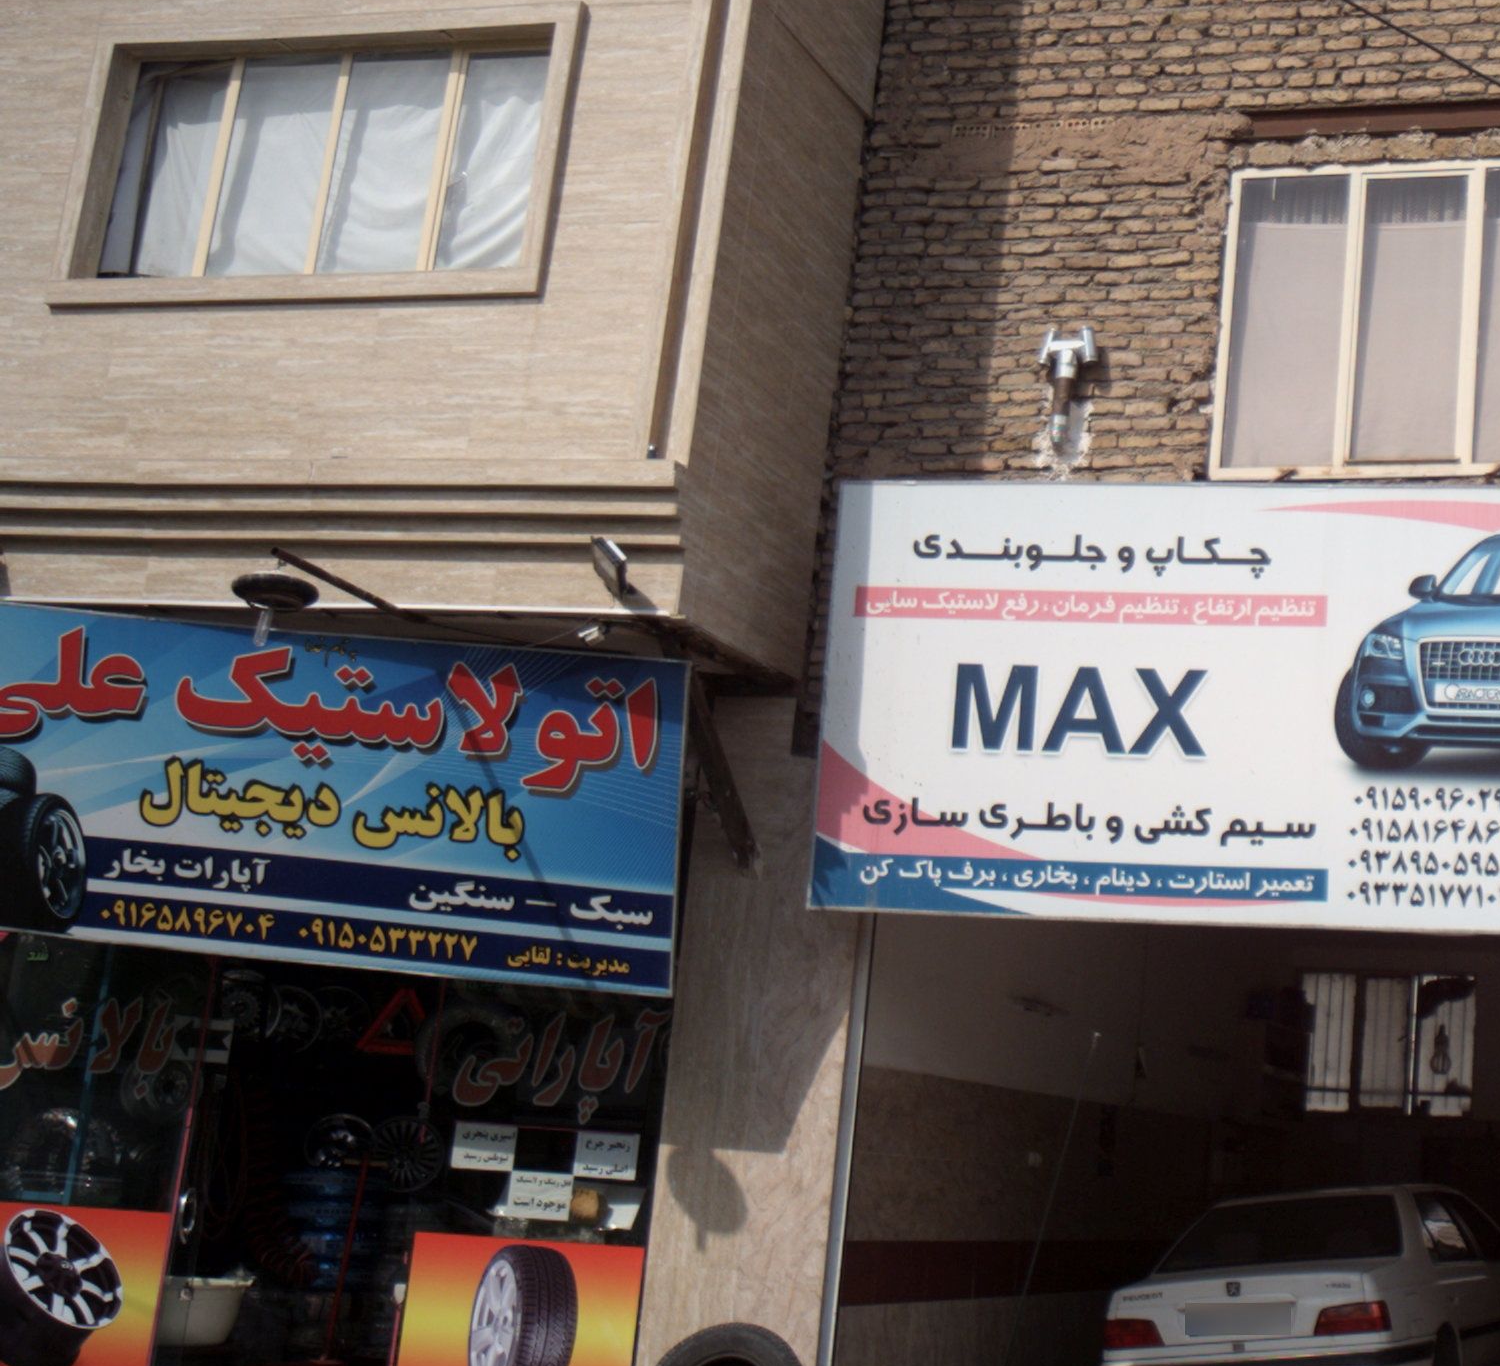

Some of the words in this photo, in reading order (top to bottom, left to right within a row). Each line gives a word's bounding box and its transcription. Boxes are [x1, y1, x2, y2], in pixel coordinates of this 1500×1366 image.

[912, 533, 1106, 571] جلوبندی
[1117, 546, 1135, 572] و
[1145, 537, 1272, 579] چکاپ
[866, 591, 918, 616] سایی
[922, 593, 999, 614] لاستیک
[1002, 594, 1040, 621] رفع
[1119, 597, 1180, 623] تنظیم
[1255, 600, 1316, 625] تنظیم
[0, 625, 148, 736] علی
[950, 662, 1208, 758] MAX
[139, 757, 341, 839] دیجیتال
[352, 785, 526, 861] بالانس
[862, 797, 968, 835] سازی
[978, 802, 1095, 839] باطری
[1105, 815, 1124, 844] و
[1134, 806, 1212, 845] کشی
[1219, 820, 1317, 847] سیم
[103, 847, 167, 882] بخار
[859, 859, 893, 885] کن
[900, 859, 942, 889] پاک
[948, 861, 997, 886] برف
[408, 880, 515, 912] سنگین
[1255, 874, 1315, 900] تعمیر
[570, 895, 654, 931] سبک
